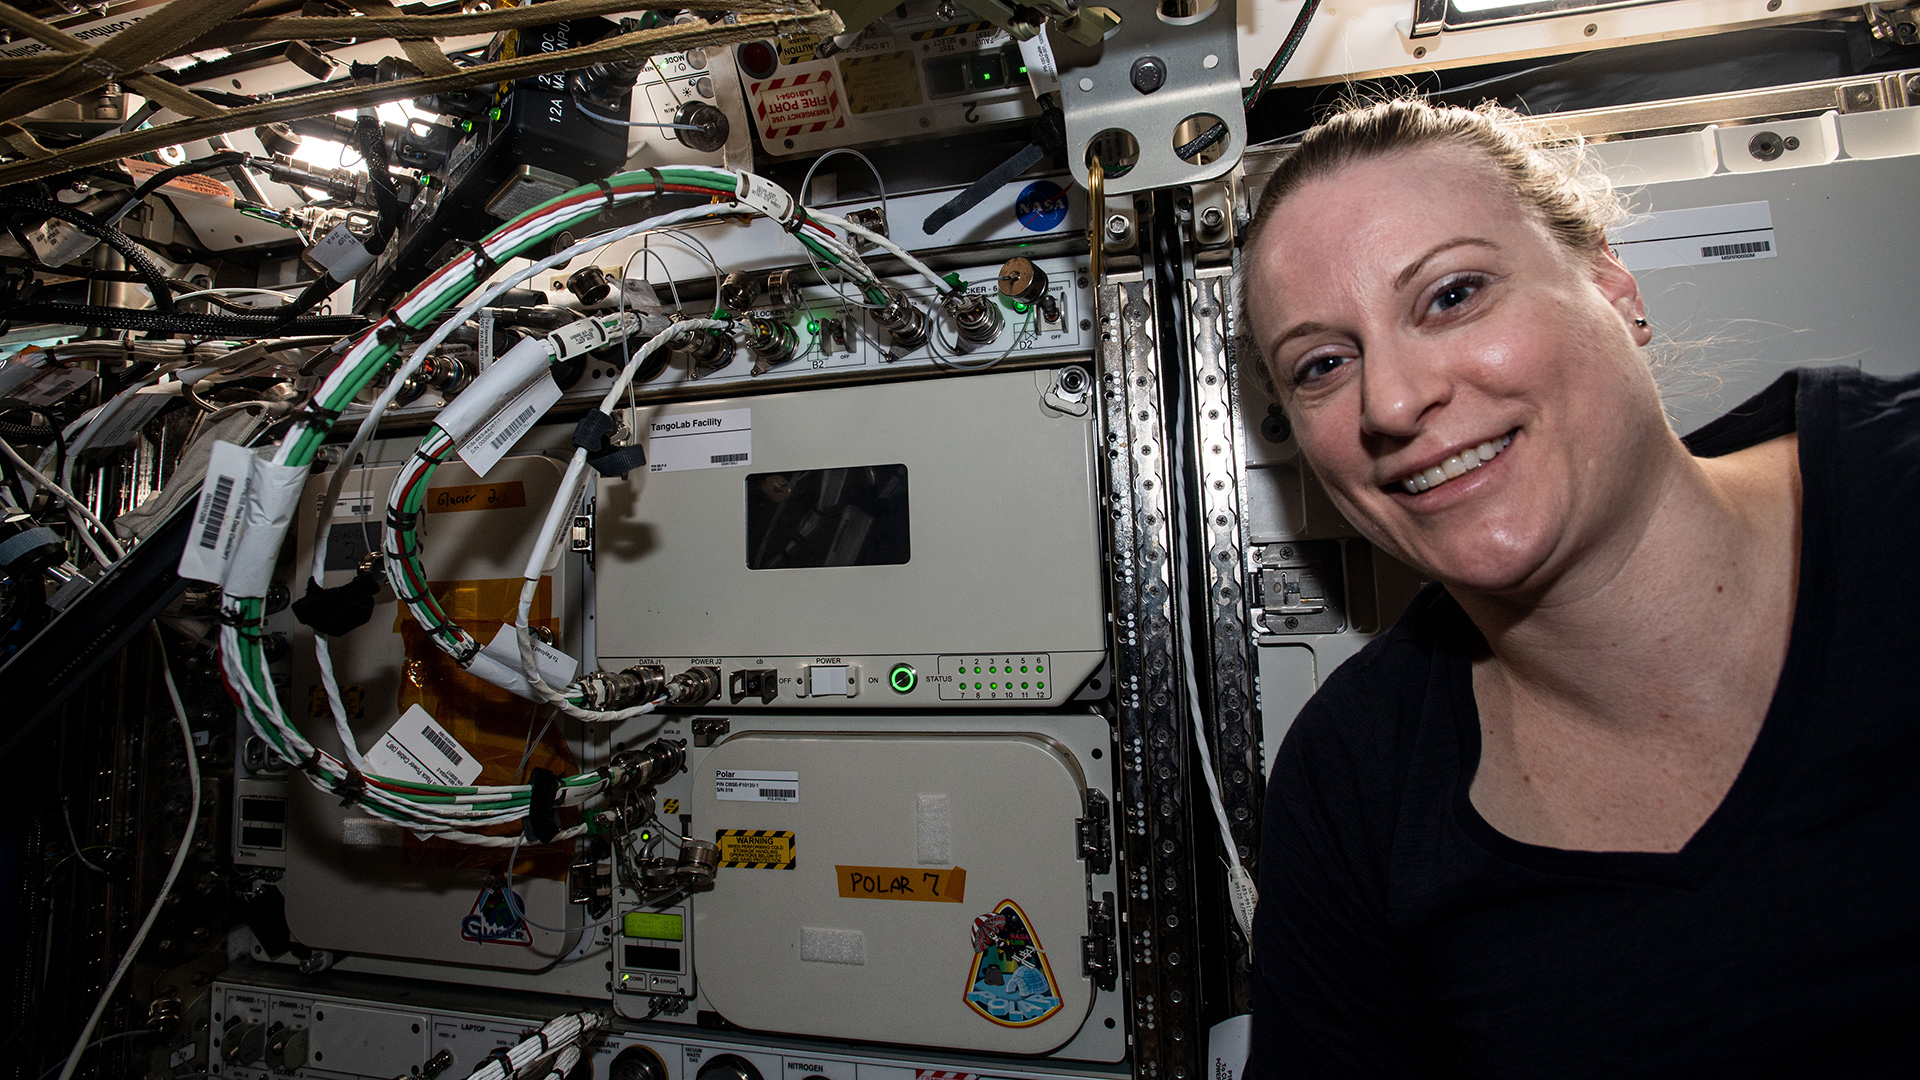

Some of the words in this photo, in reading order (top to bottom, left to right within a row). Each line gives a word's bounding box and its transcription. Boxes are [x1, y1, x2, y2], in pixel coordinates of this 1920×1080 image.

[73, 21, 132, 41] combus
[665, 54, 685, 64] MODE
[769, 100, 799, 114] PORT
[803, 95, 828, 109] FIRE
[549, 99, 563, 122] 12A
[788, 109, 830, 120] EMERGENCY
[963, 101, 980, 124] 2
[772, 115, 786, 124] USE
[1020, 199, 1065, 214] NASA
[1019, 341, 1033, 350] D2
[812, 361, 824, 369] B2
[651, 421, 691, 432] TangoLab
[692, 418, 722, 428] Facility
[437, 490, 477, 507] Glacier
[488, 488, 500, 504] 2
[344, 541, 358, 562] 2
[816, 657, 842, 665] POWER
[778, 677, 792, 685] OFF
[868, 677, 879, 685] ON
[925, 675, 953, 683] STATUS
[397, 750, 410, 764] Cable
[409, 761, 423, 775] Power
[716, 770, 736, 778] Polar
[736, 837, 774, 845] WARNING
[851, 872, 914, 895] POLAR
[922, 873, 940, 897] 7
[462, 914, 525, 946] GLACIER
[966, 990, 1060, 1022] POLAR
[461, 1024, 486, 1033] LAPTOP
[788, 1062, 824, 1073] NITROGEN
